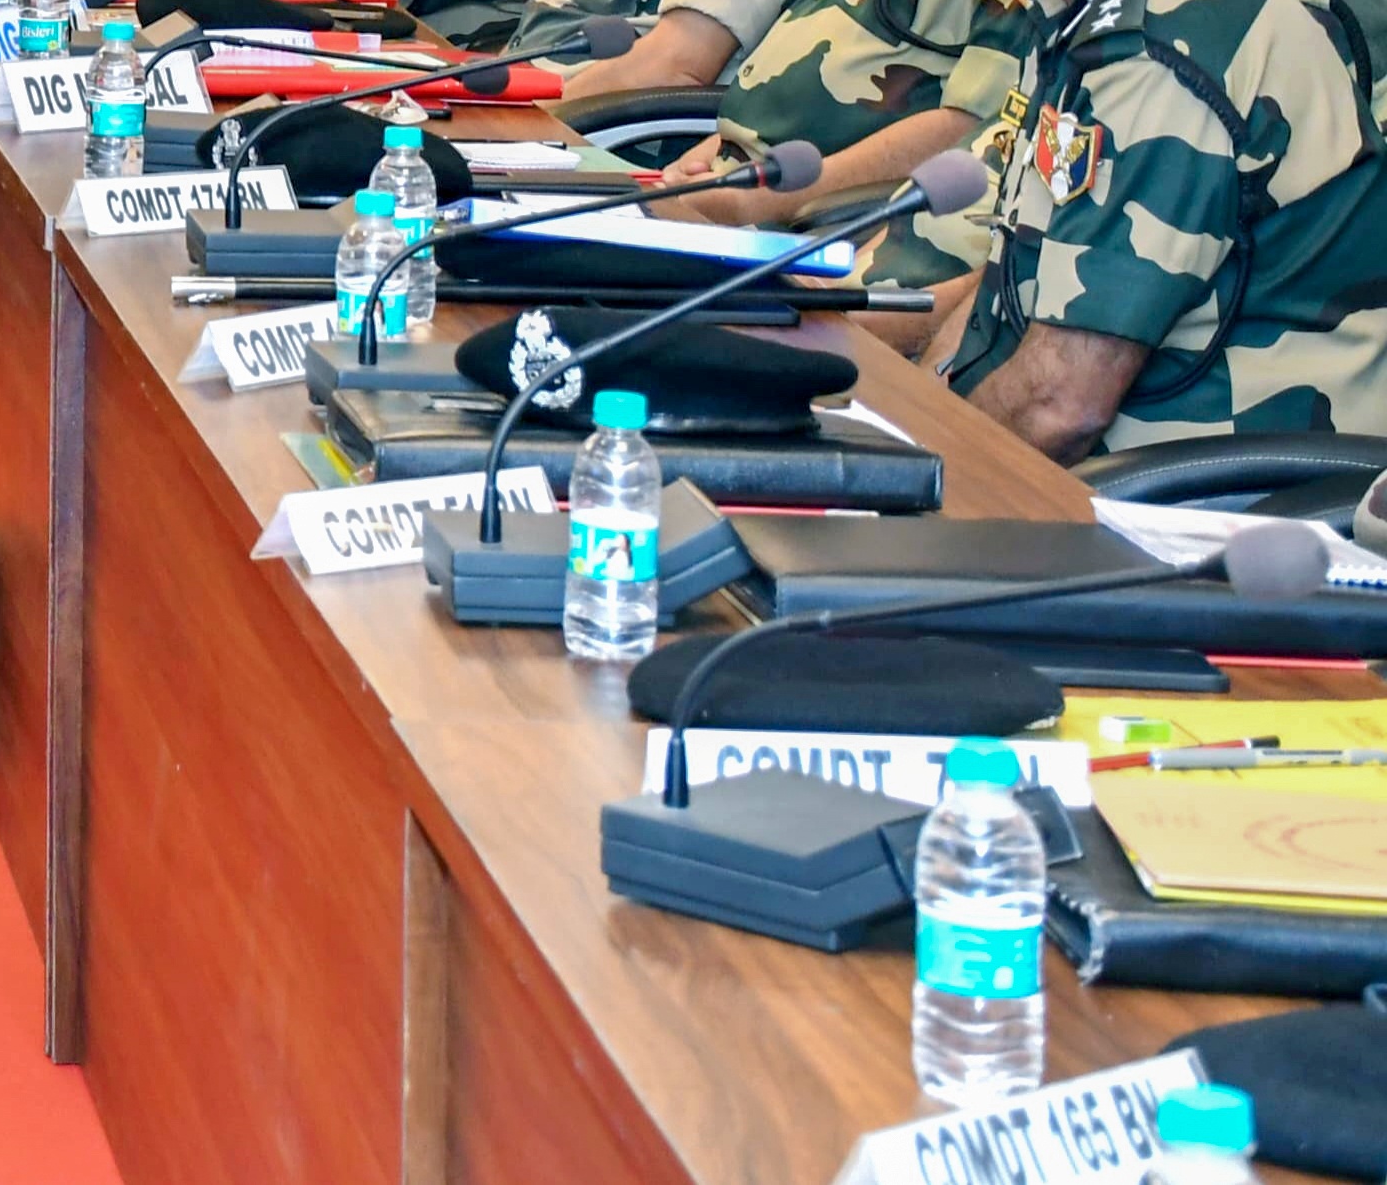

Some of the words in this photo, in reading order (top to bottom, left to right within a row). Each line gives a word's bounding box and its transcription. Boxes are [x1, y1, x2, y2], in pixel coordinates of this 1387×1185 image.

[21, 26, 55, 39] Bisleri
[23, 74, 73, 115] DIG
[106, 186, 186, 224] COMDT
[1047, 1091, 1121, 1175] 165
